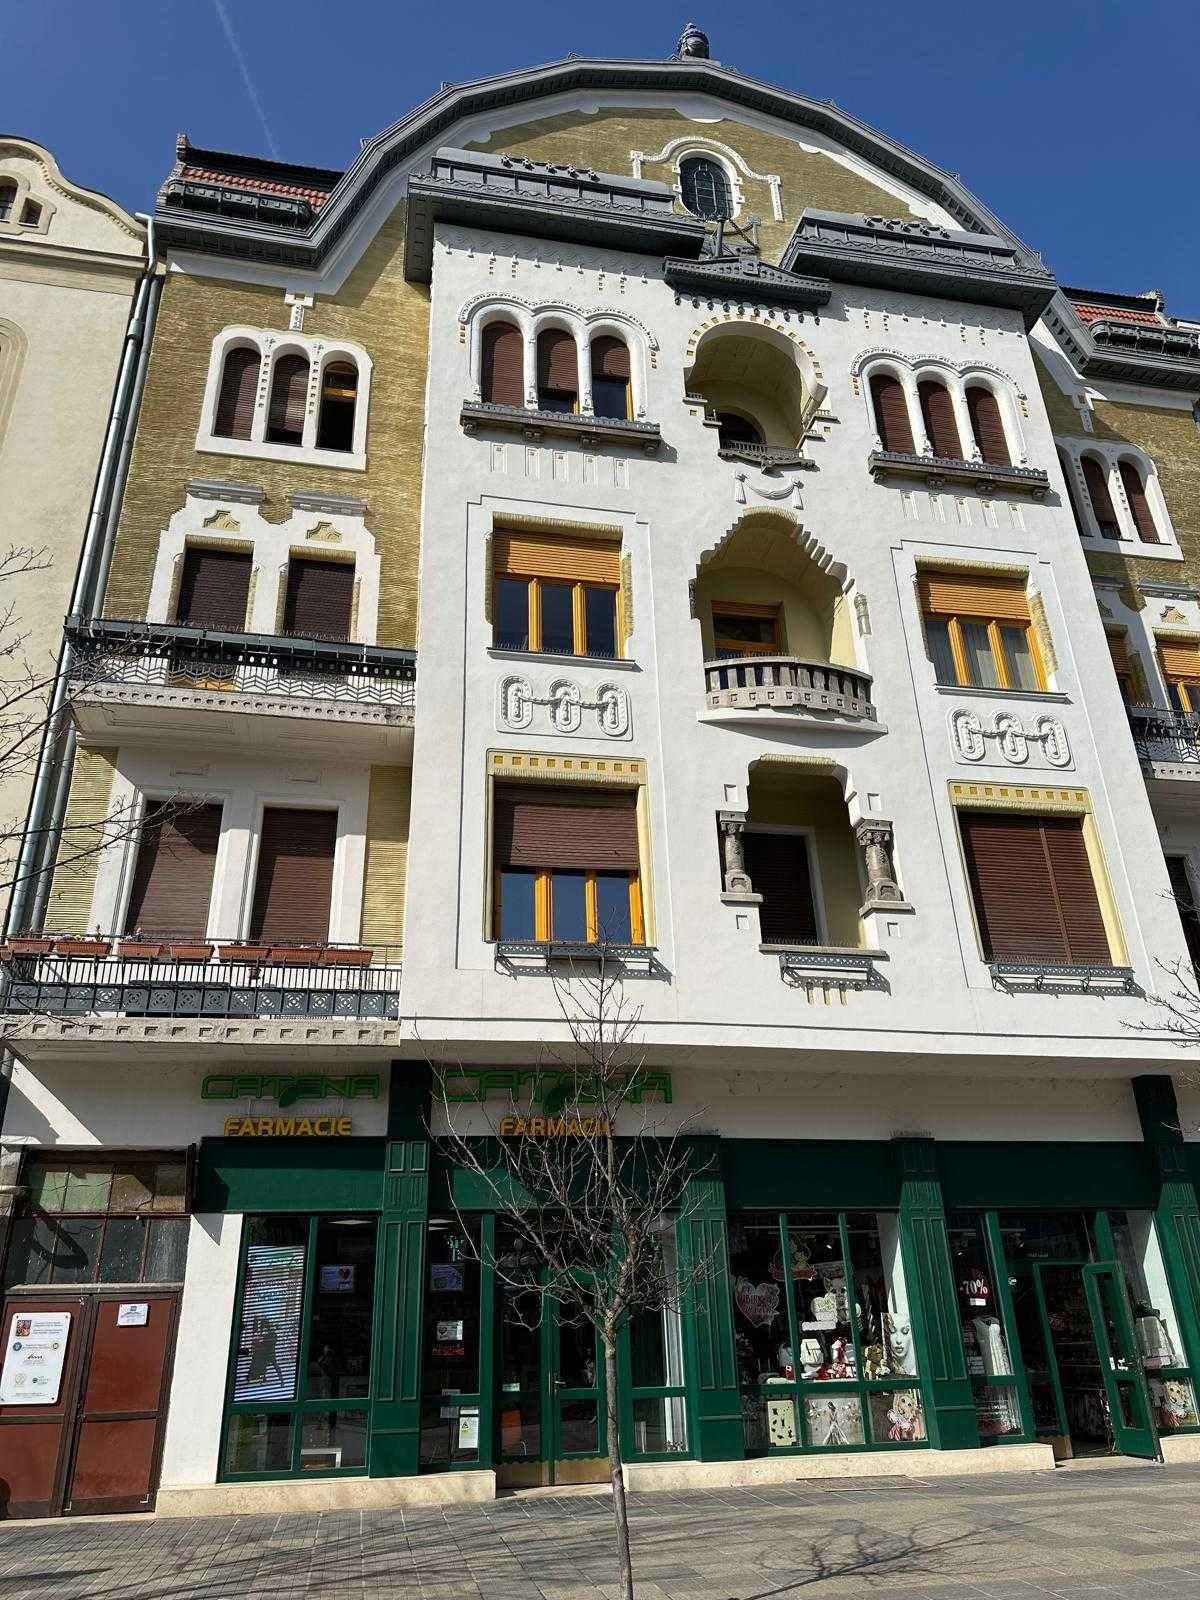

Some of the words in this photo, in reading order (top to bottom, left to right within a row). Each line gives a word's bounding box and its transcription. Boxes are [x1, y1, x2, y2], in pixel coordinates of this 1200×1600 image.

[201, 1074, 380, 1100] CATENA
[223, 1116, 352, 1136] FARMACIE
[960, 1278, 989, 1295] -70%
